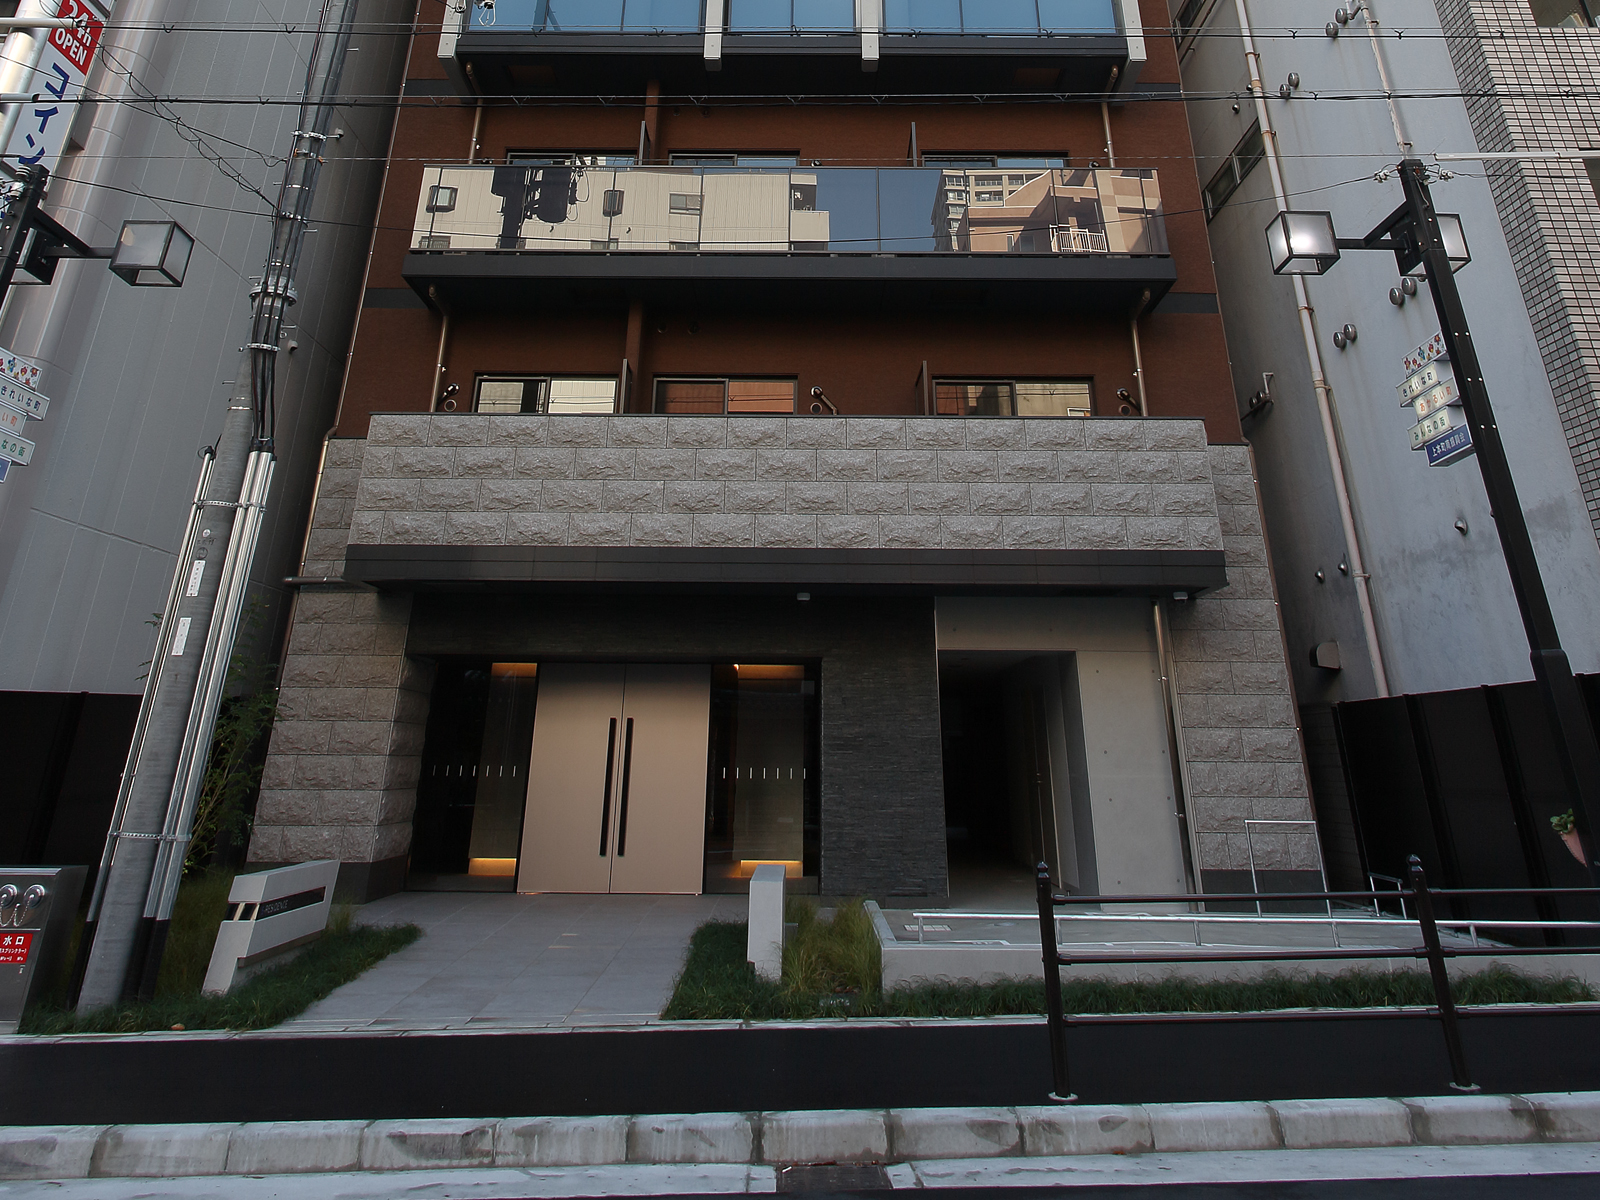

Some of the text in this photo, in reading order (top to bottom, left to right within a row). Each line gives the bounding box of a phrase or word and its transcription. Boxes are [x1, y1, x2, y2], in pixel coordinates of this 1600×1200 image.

[54, 27, 88, 66] OPEN
[1402, 371, 1434, 398] きれいな町
[0, 385, 41, 411] きれいな町
[1419, 386, 1452, 412] あかるい町
[1413, 416, 1446, 441] みんなの街
